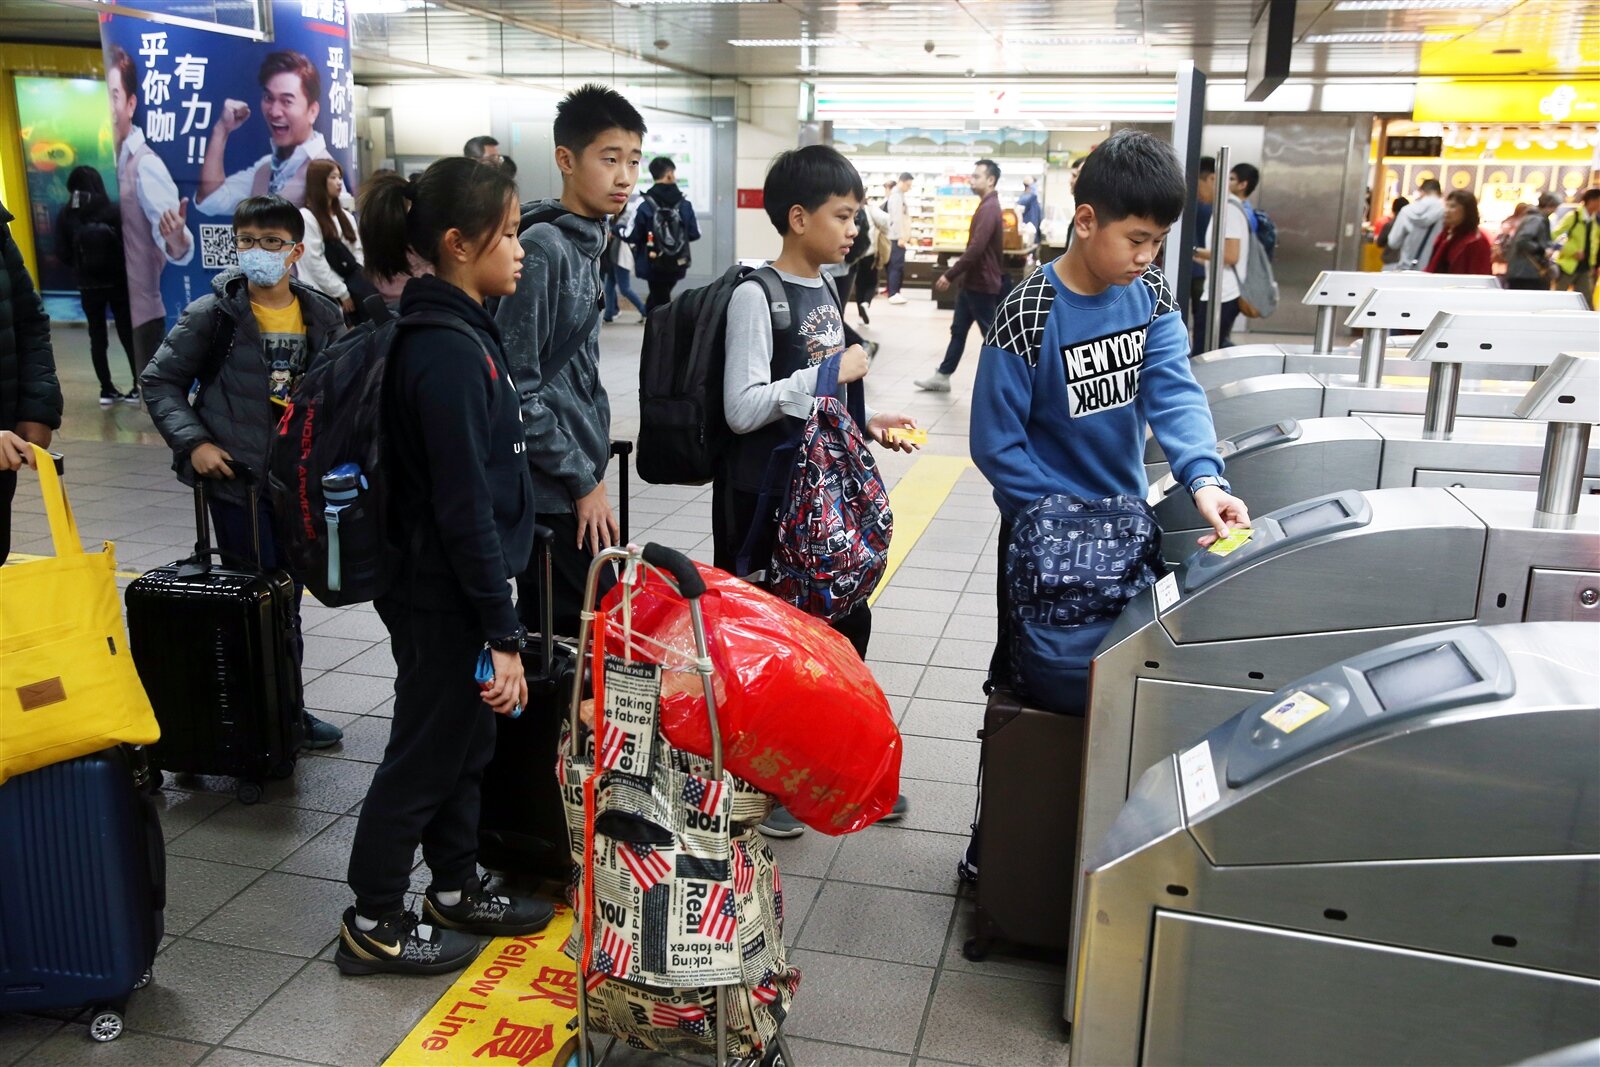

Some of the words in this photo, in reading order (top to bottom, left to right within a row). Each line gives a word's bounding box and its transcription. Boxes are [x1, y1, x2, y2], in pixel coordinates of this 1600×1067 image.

[139, 31, 176, 143] 乎你咖
[615, 695, 652, 714] taking
[615, 708, 652, 726] fabrex
[620, 732, 636, 771] eal
[685, 809, 721, 834] FOR
[631, 886, 640, 930] Place
[685, 883, 708, 935] Real
[631, 931, 640, 974] Going
[670, 942, 712, 956] fabrex
[714, 942, 733, 953] the
[469, 935, 545, 998] Yellow
[671, 953, 713, 968] taking
[605, 981, 639, 998] Place
[641, 992, 681, 1004] Going
[421, 1000, 488, 1051] Line
